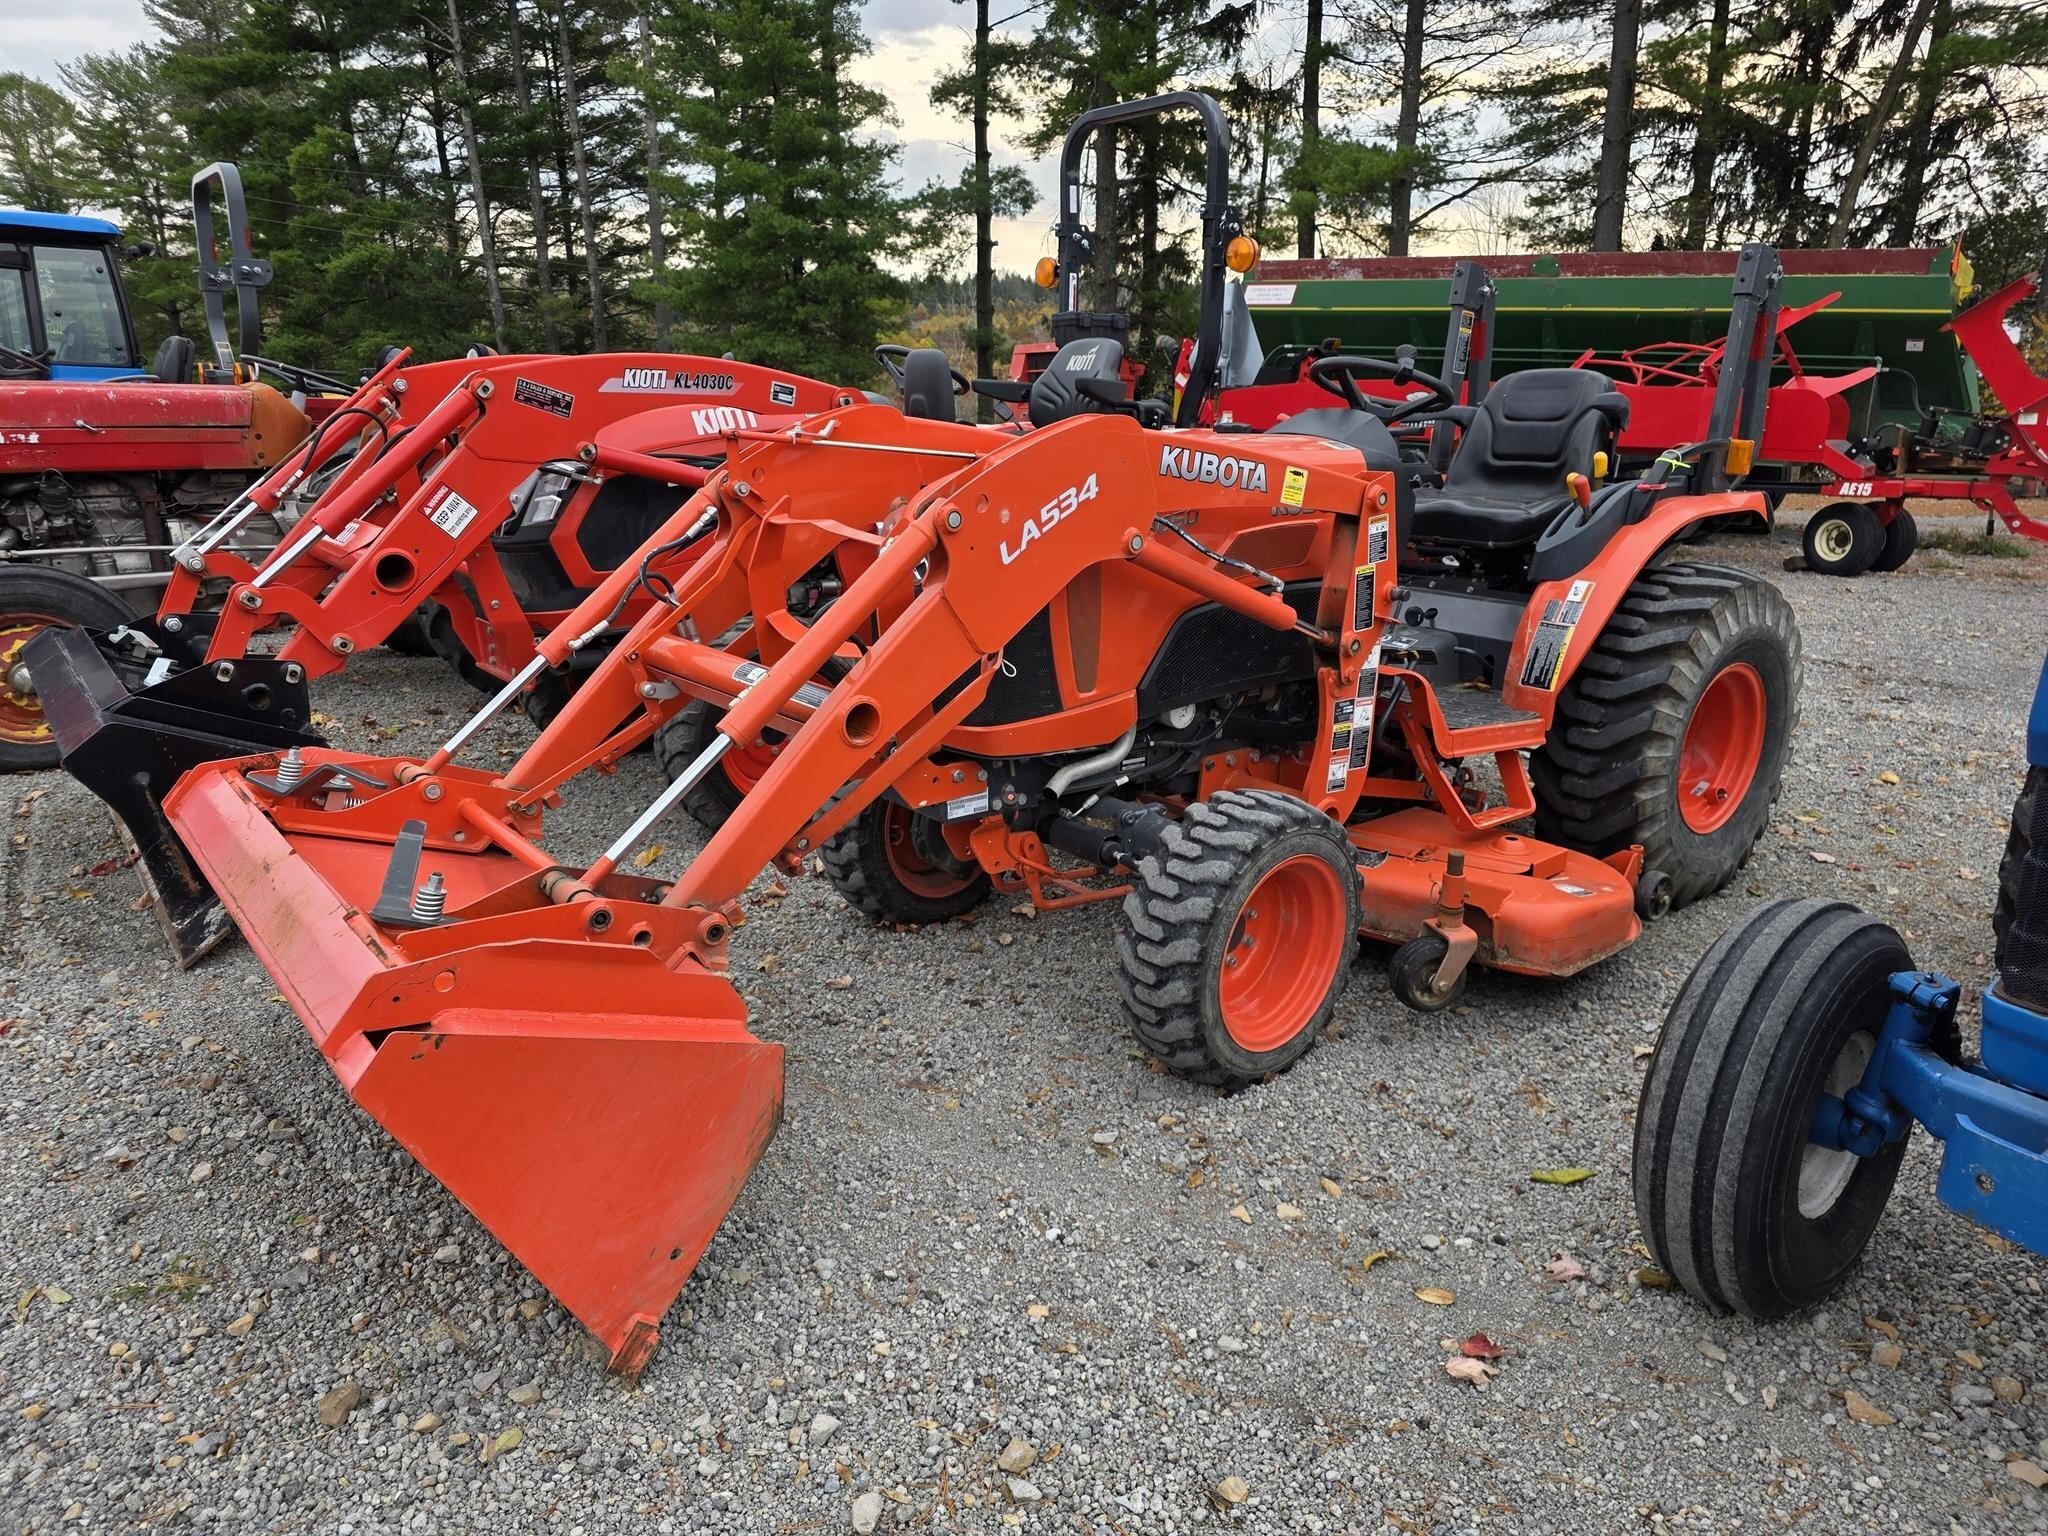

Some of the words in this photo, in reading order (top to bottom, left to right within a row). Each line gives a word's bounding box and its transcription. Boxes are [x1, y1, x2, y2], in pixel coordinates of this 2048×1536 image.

[1065, 347, 1098, 371] KIOTI
[622, 368, 668, 389] KIOTI
[674, 373, 734, 390] KL4030C
[691, 406, 758, 435] KIOTI
[1159, 444, 1268, 493] KUBOTA
[427, 485, 449, 508] WARNING
[1839, 482, 1873, 496] AE15
[435, 510, 450, 526] KEEP
[446, 495, 463, 514] AWAY
[1000, 472, 1099, 565] LA534
